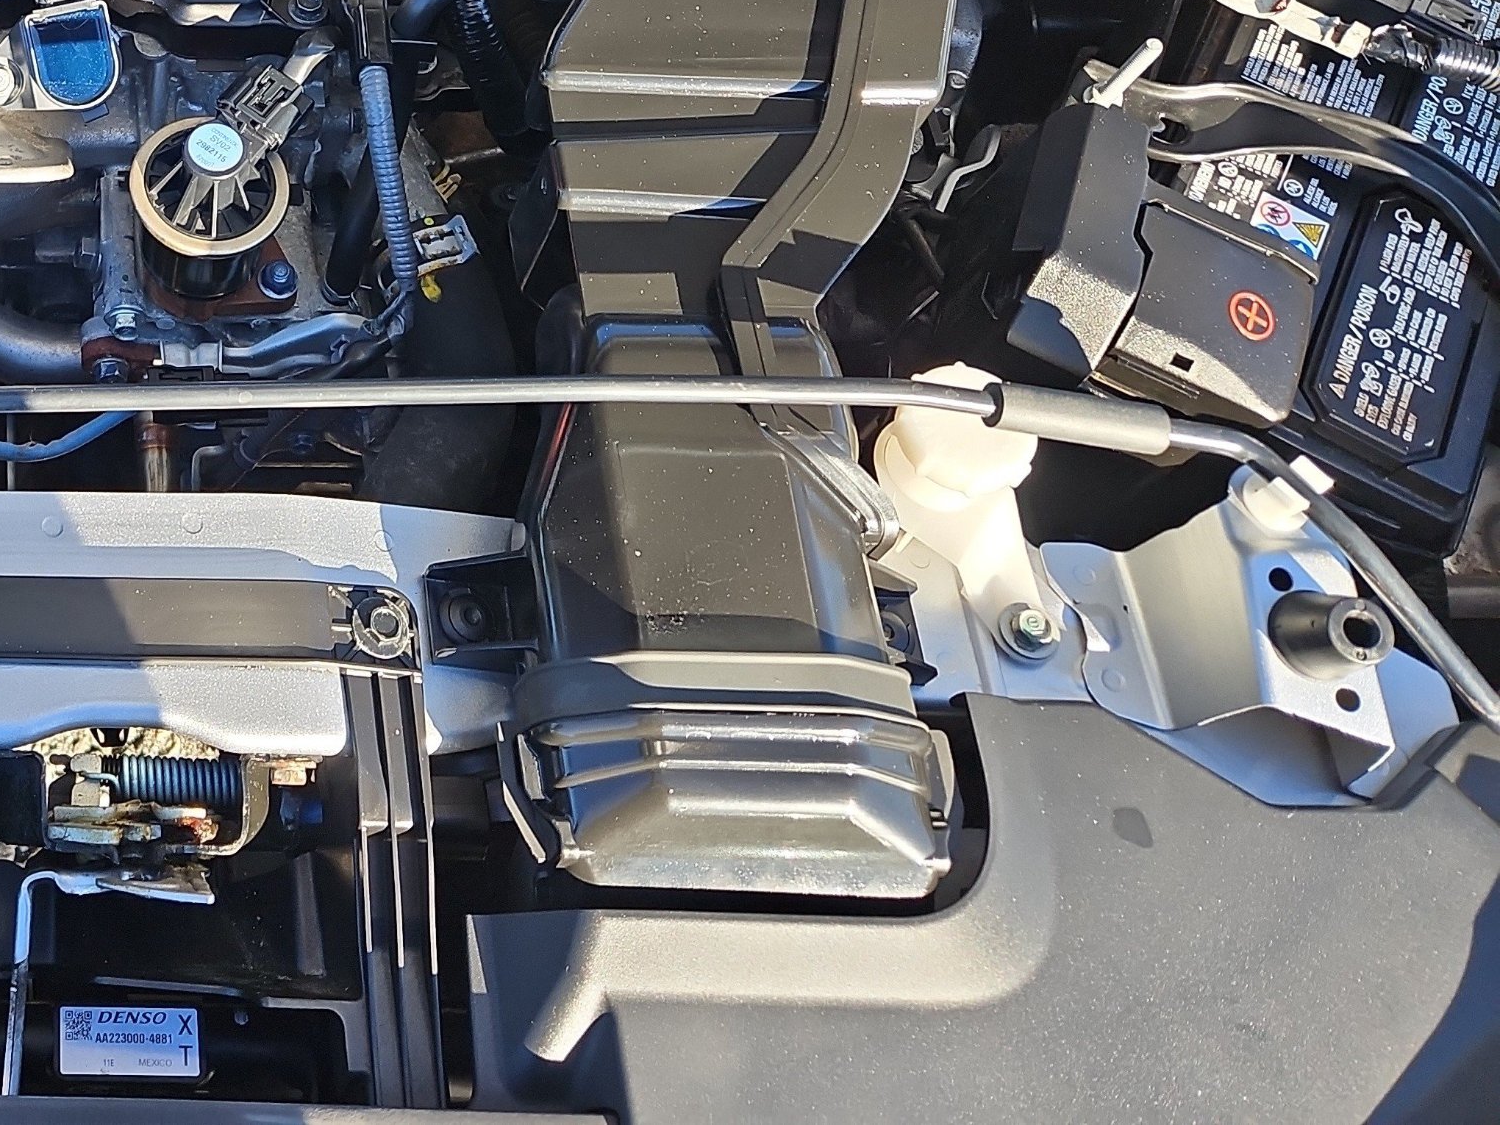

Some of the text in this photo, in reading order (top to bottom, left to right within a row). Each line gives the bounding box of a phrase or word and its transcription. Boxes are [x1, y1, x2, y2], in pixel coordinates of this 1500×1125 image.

[97, 1011, 166, 1024] DENSO
[178, 1015, 193, 1035] X
[95, 1033, 172, 1044] AA223000-4881
[178, 1045, 193, 1066] T
[138, 1059, 172, 1067] MEXICO
